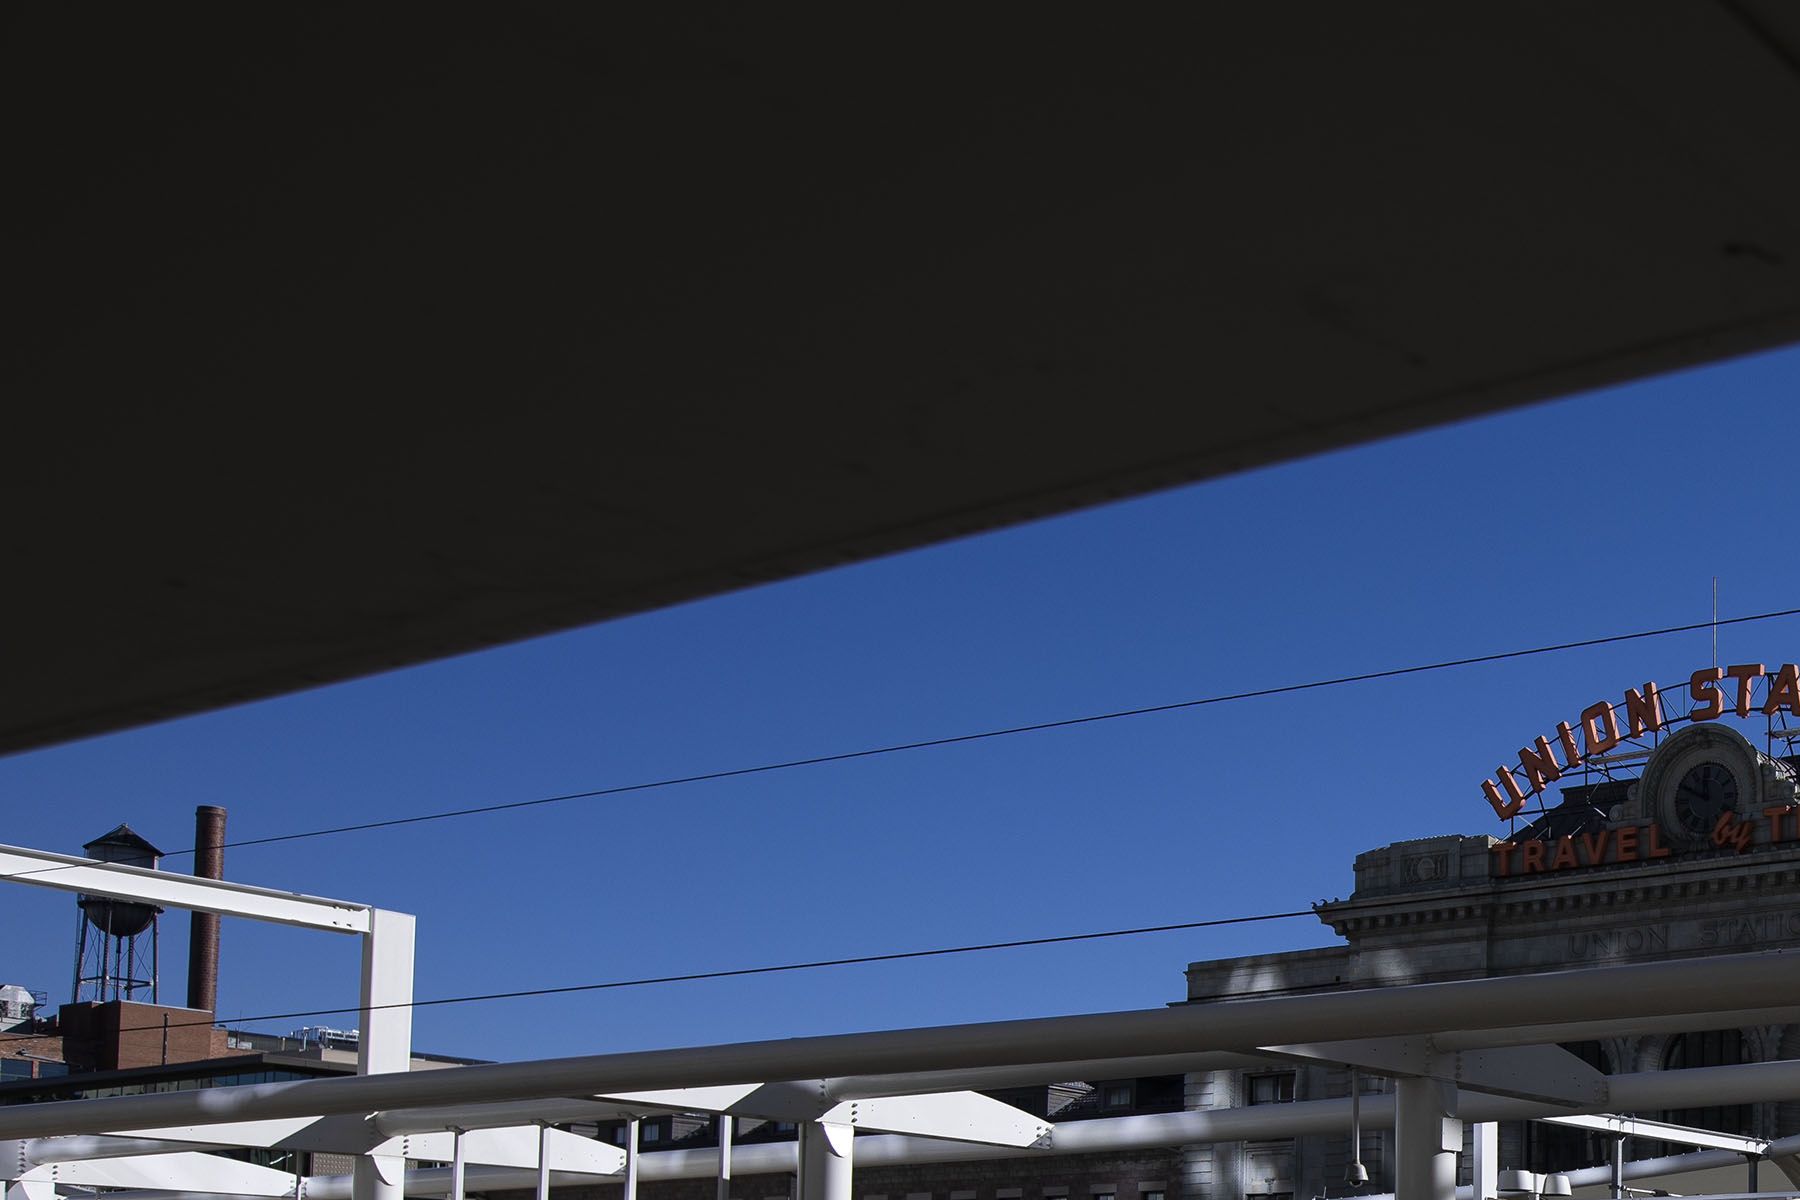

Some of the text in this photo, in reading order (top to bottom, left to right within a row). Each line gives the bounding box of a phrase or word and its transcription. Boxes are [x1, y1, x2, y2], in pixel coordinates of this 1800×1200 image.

[1481, 681, 1663, 820] UNION
[1491, 822, 1671, 878] TRAVEL
[1710, 810, 1754, 855] by
[1568, 924, 1671, 956] UNION
